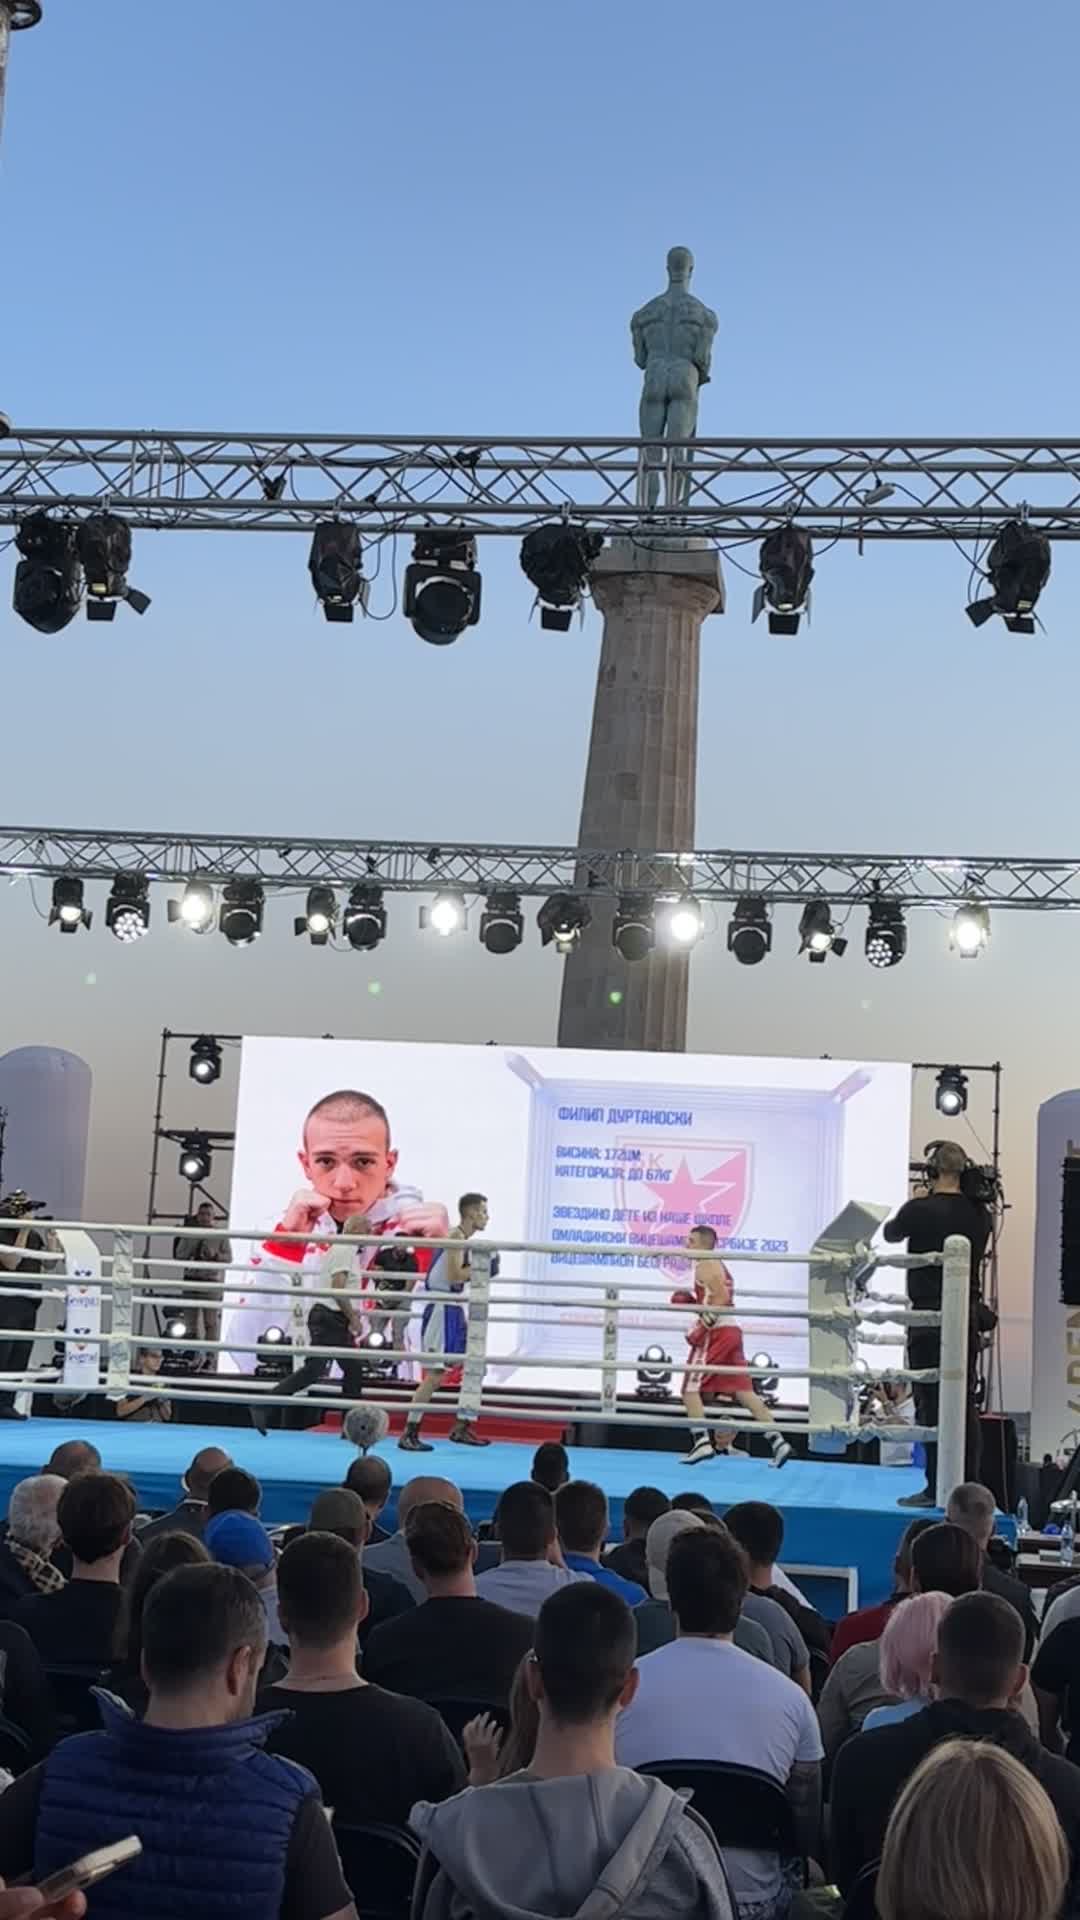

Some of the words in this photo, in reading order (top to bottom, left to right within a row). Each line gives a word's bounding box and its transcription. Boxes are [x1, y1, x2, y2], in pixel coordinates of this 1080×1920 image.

[558, 1106, 604, 1121] ФИЛИП
[628, 1167, 642, 1182] ДО
[552, 1206, 610, 1221] ЗВЕЗДИНО
[612, 1208, 640, 1222] ДЕТЕ
[643, 1210, 657, 1222] ИЗ
[761, 1239, 788, 1252] 2023
